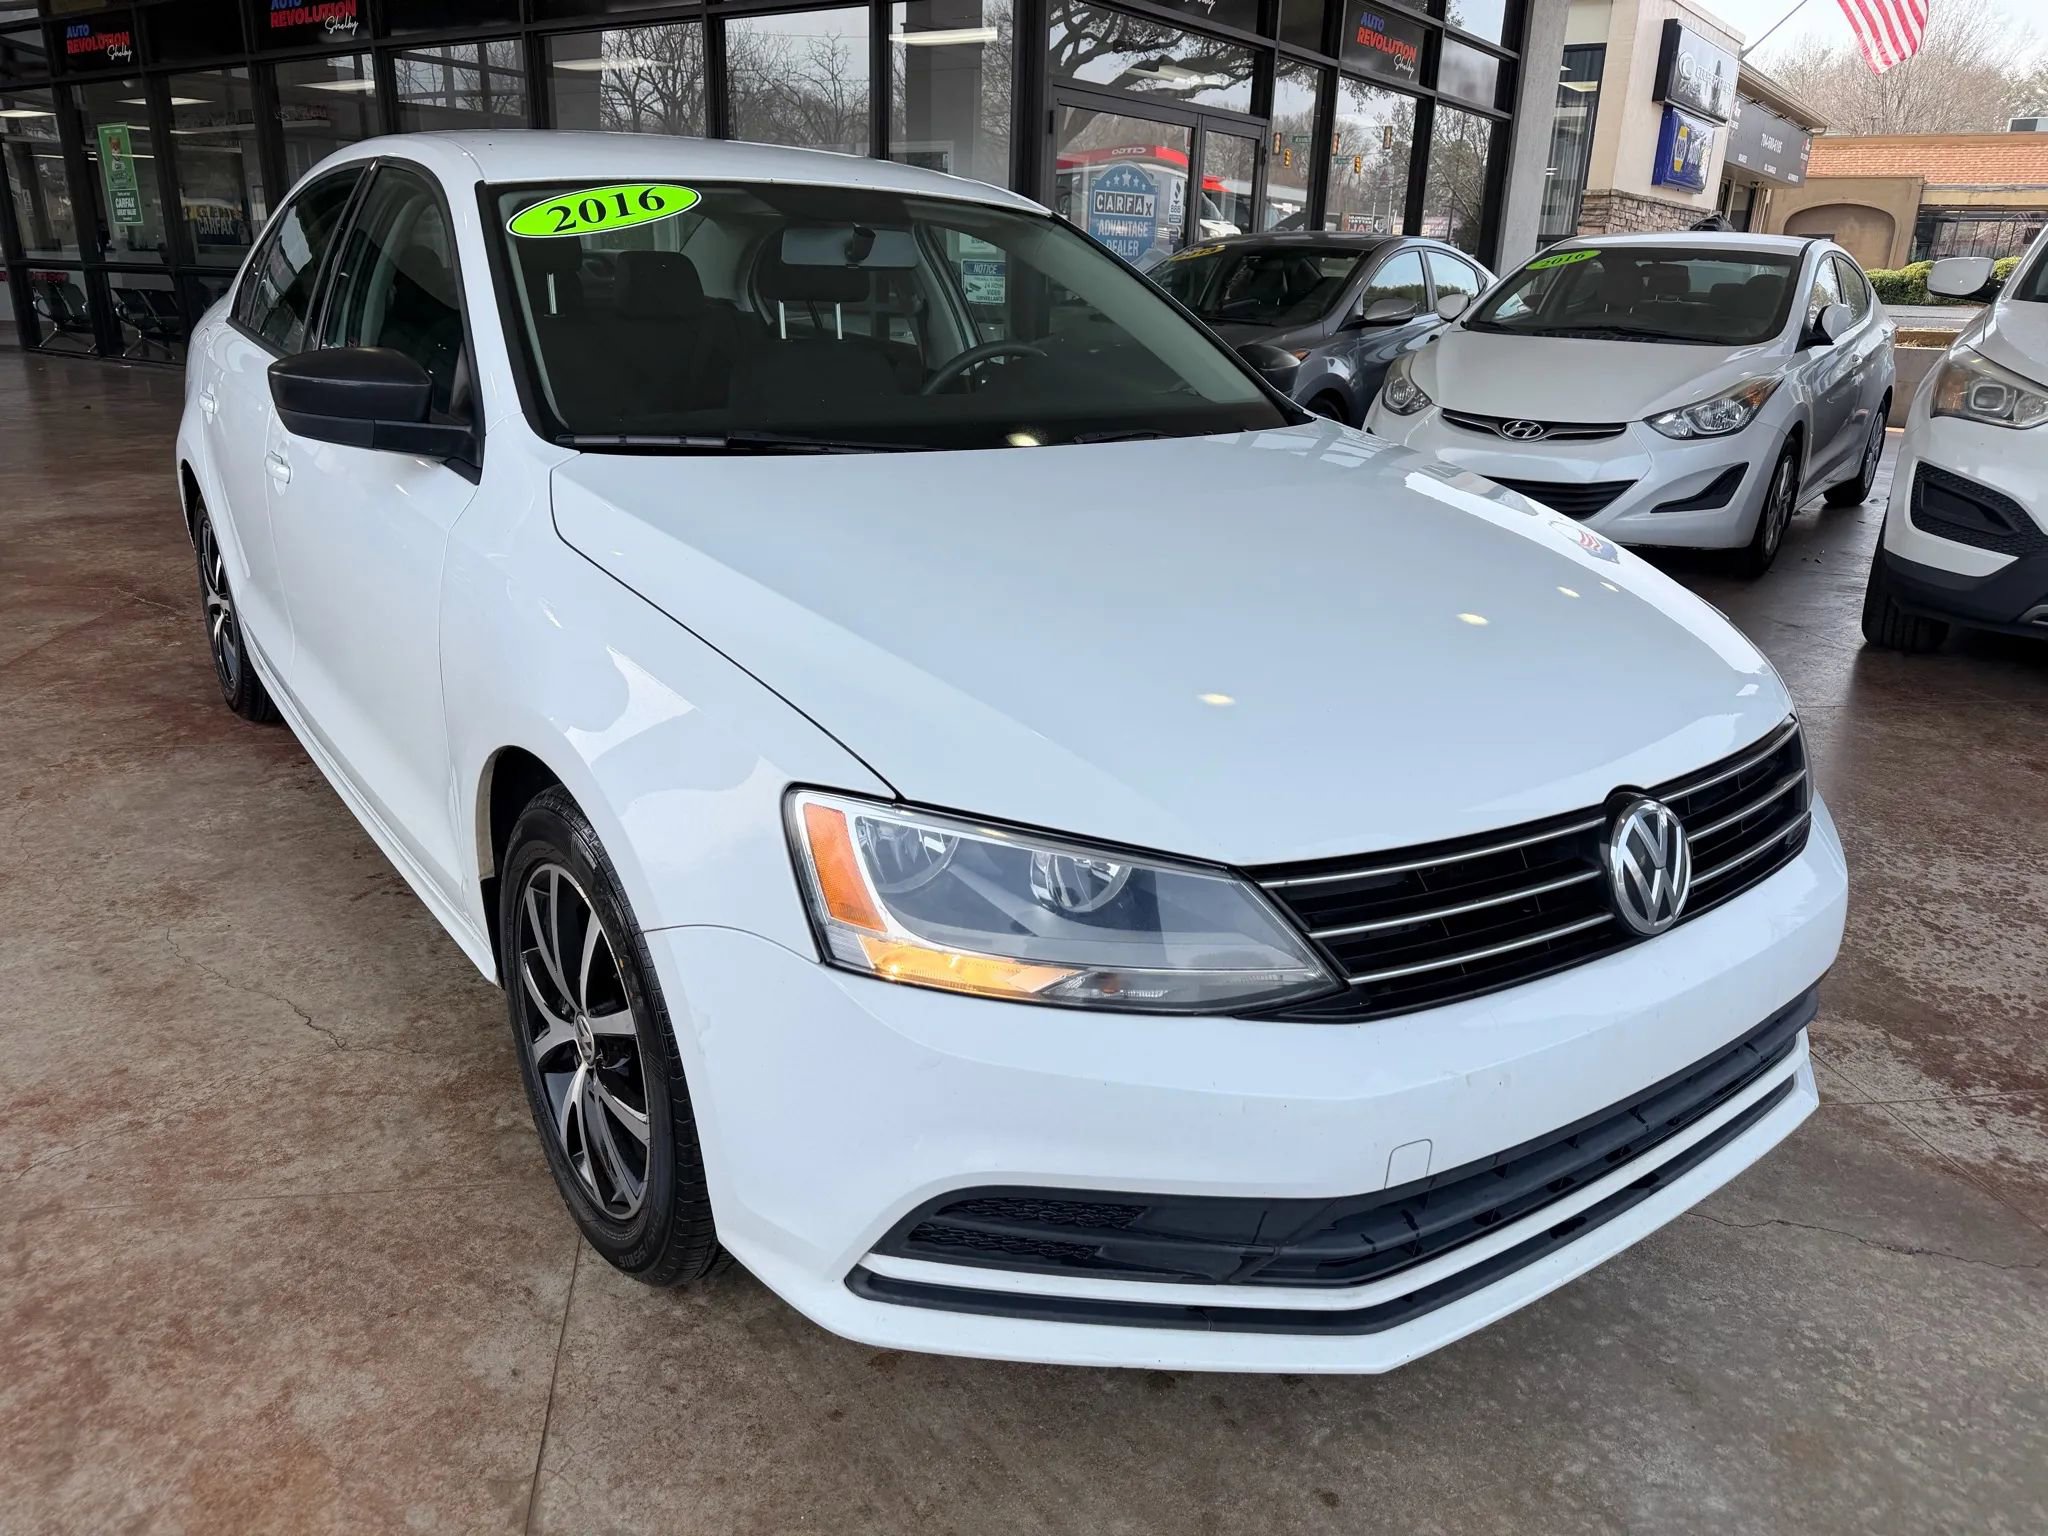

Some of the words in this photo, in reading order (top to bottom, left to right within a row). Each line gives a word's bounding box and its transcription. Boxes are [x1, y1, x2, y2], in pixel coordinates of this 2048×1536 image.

[271, 0, 357, 28] REVOLUTION
[325, 12, 359, 36] Shelby
[1361, 12, 1385, 32] AUTO
[67, 24, 90, 38] AUTO
[67, 32, 129, 54] REVOLUTION
[107, 42, 132, 63] Shelby
[1357, 27, 1418, 63] REVOLUTION
[1394, 54, 1415, 79] Shelby
[115, 197, 135, 209] CARFAX
[547, 187, 665, 232] 2016
[1096, 194, 1153, 217] CARFAX
[197, 216, 234, 235] CARFAX
[1097, 219, 1149, 238] ADVANTAGE
[1107, 240, 1139, 257] DEALER
[973, 264, 998, 274] NOTICE
[1541, 253, 1585, 267] 2016
